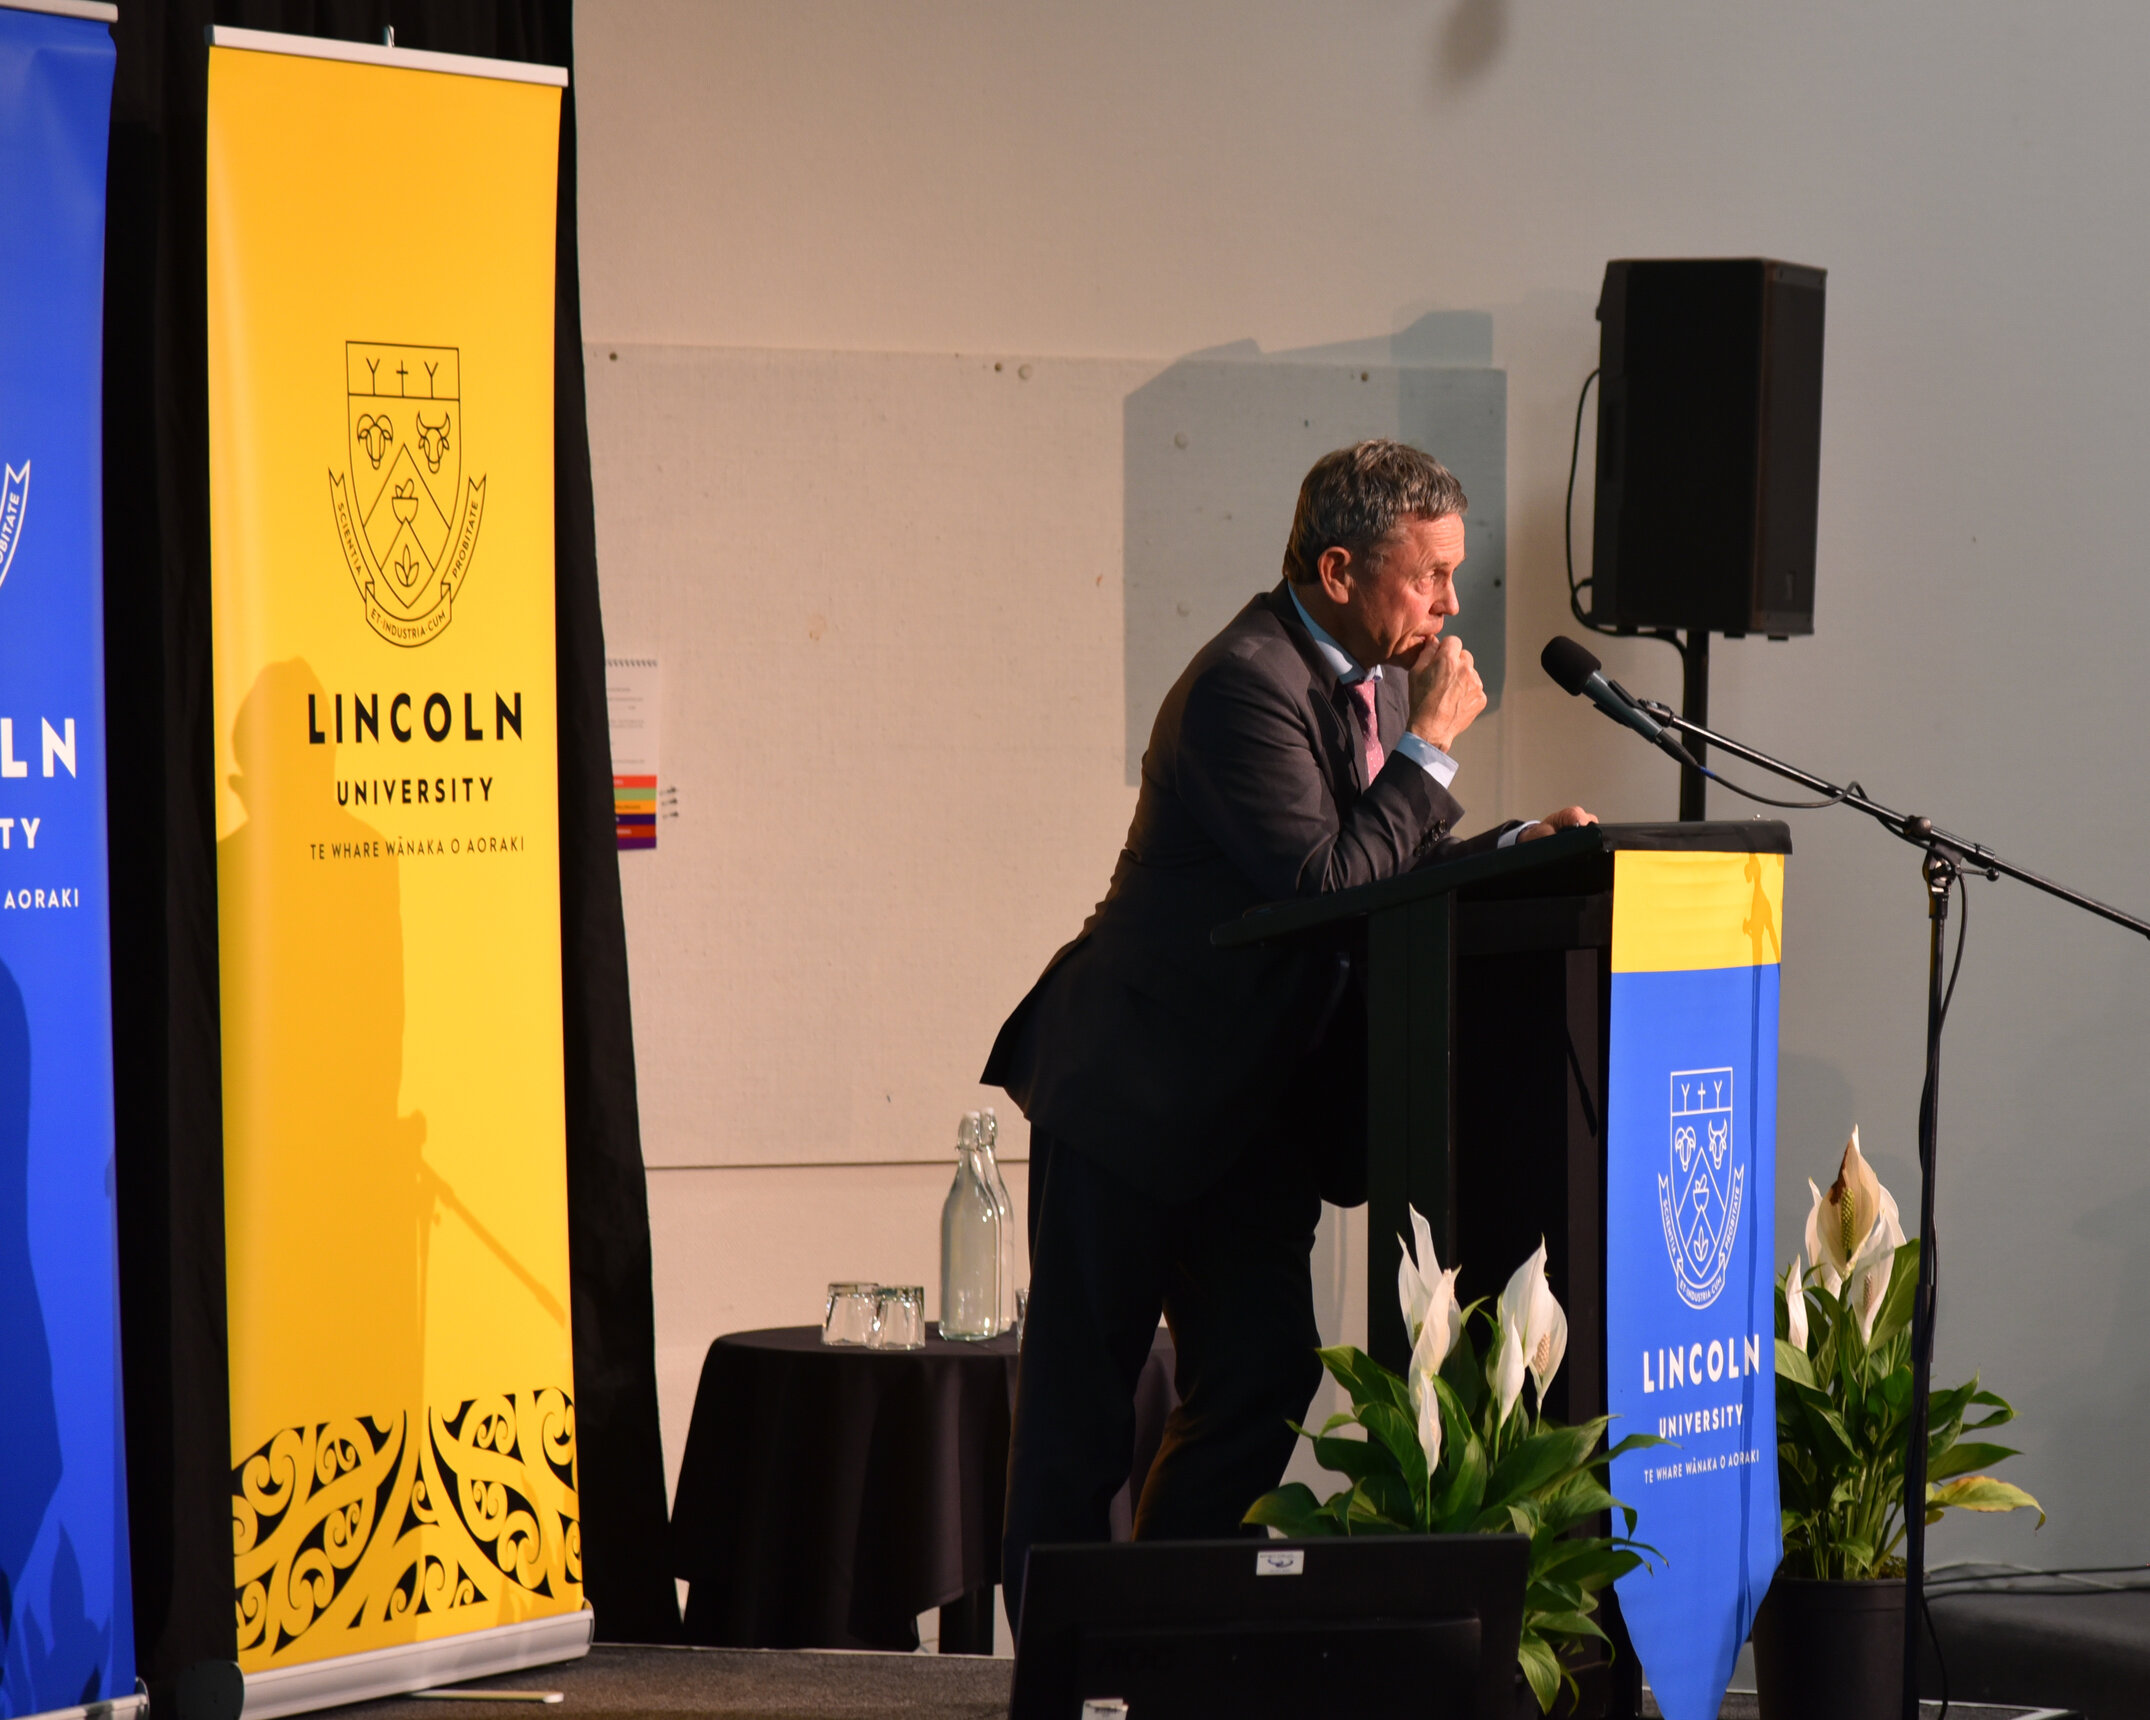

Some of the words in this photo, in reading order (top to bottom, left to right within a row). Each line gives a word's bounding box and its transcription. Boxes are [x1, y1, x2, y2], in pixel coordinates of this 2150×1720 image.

[336, 502, 362, 577] SCIENTIA
[451, 500, 479, 579] PROBITATE
[308, 691, 523, 744] LINCOLN
[336, 776, 494, 806] UNIVERSITY
[310, 844, 325, 861] TE
[331, 841, 380, 860] WHARE
[451, 838, 460, 854] O
[466, 836, 525, 853] AORAKI
[4, 888, 80, 910] AORAKI
[1662, 1198, 1677, 1258] SCIENTIA
[1724, 1186, 1741, 1251] PROBITATE
[1643, 1333, 1760, 1394] LINCOLN
[1658, 1403, 1744, 1440] UNIVERSITY
[1644, 1468, 1654, 1484] TE
[1656, 1462, 1683, 1481] WHARE
[1719, 1454, 1726, 1469] O
[1728, 1448, 1760, 1467] AORAKI
